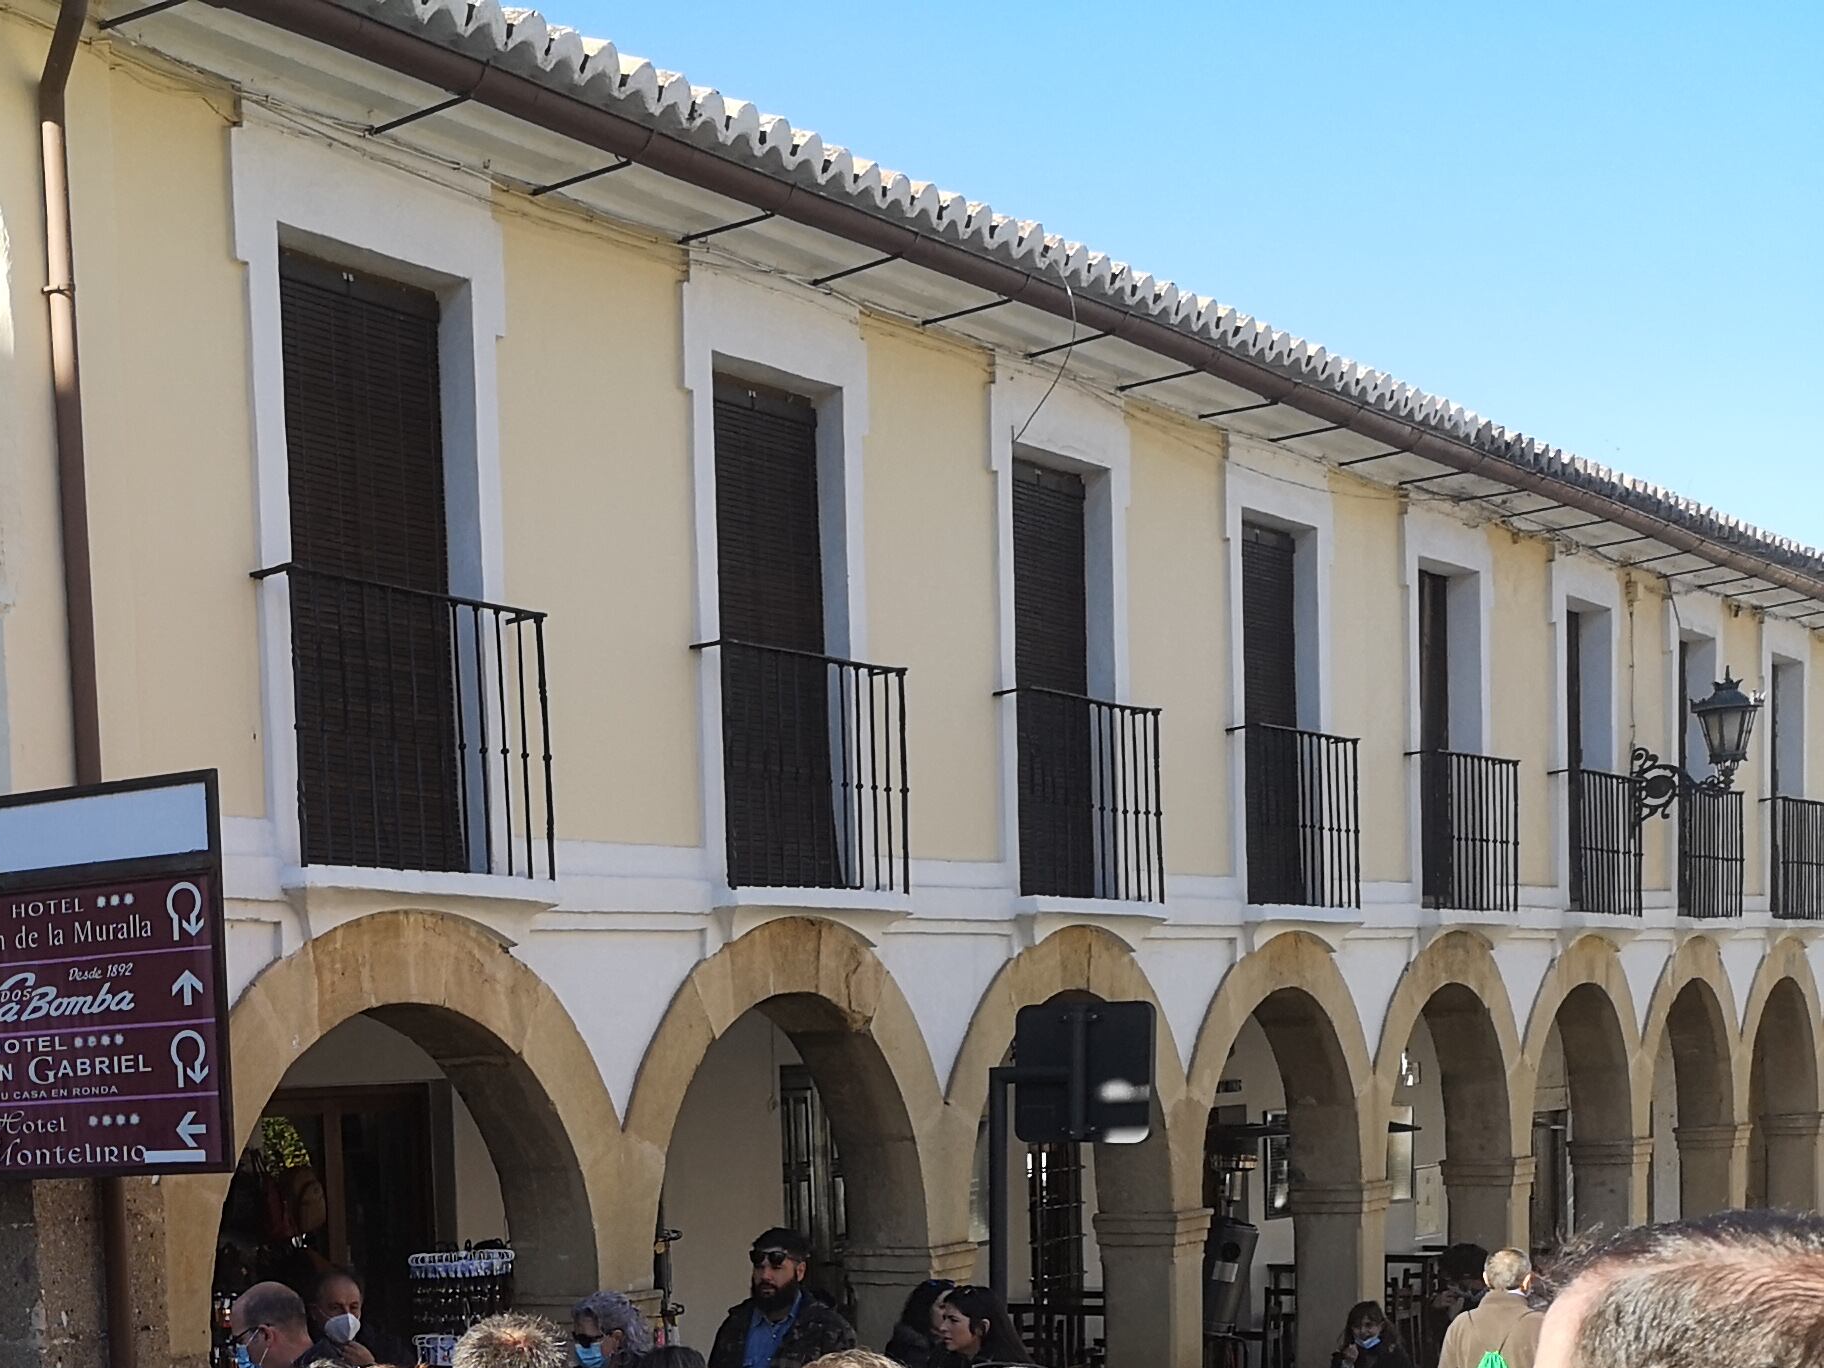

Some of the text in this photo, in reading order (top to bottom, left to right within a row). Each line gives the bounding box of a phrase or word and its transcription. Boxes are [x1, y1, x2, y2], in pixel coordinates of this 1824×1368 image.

[12, 898, 84, 918] HOTEL
[15, 925, 39, 950] de
[48, 922, 64, 946] la
[74, 914, 152, 944] Muralla
[68, 962, 134, 982] Desde 1892
[28, 1054, 153, 1085] GABRIEL
[13, 1090, 48, 1101] CASA
[51, 1088, 68, 1098] EN
[72, 1085, 118, 1097] RONDA
